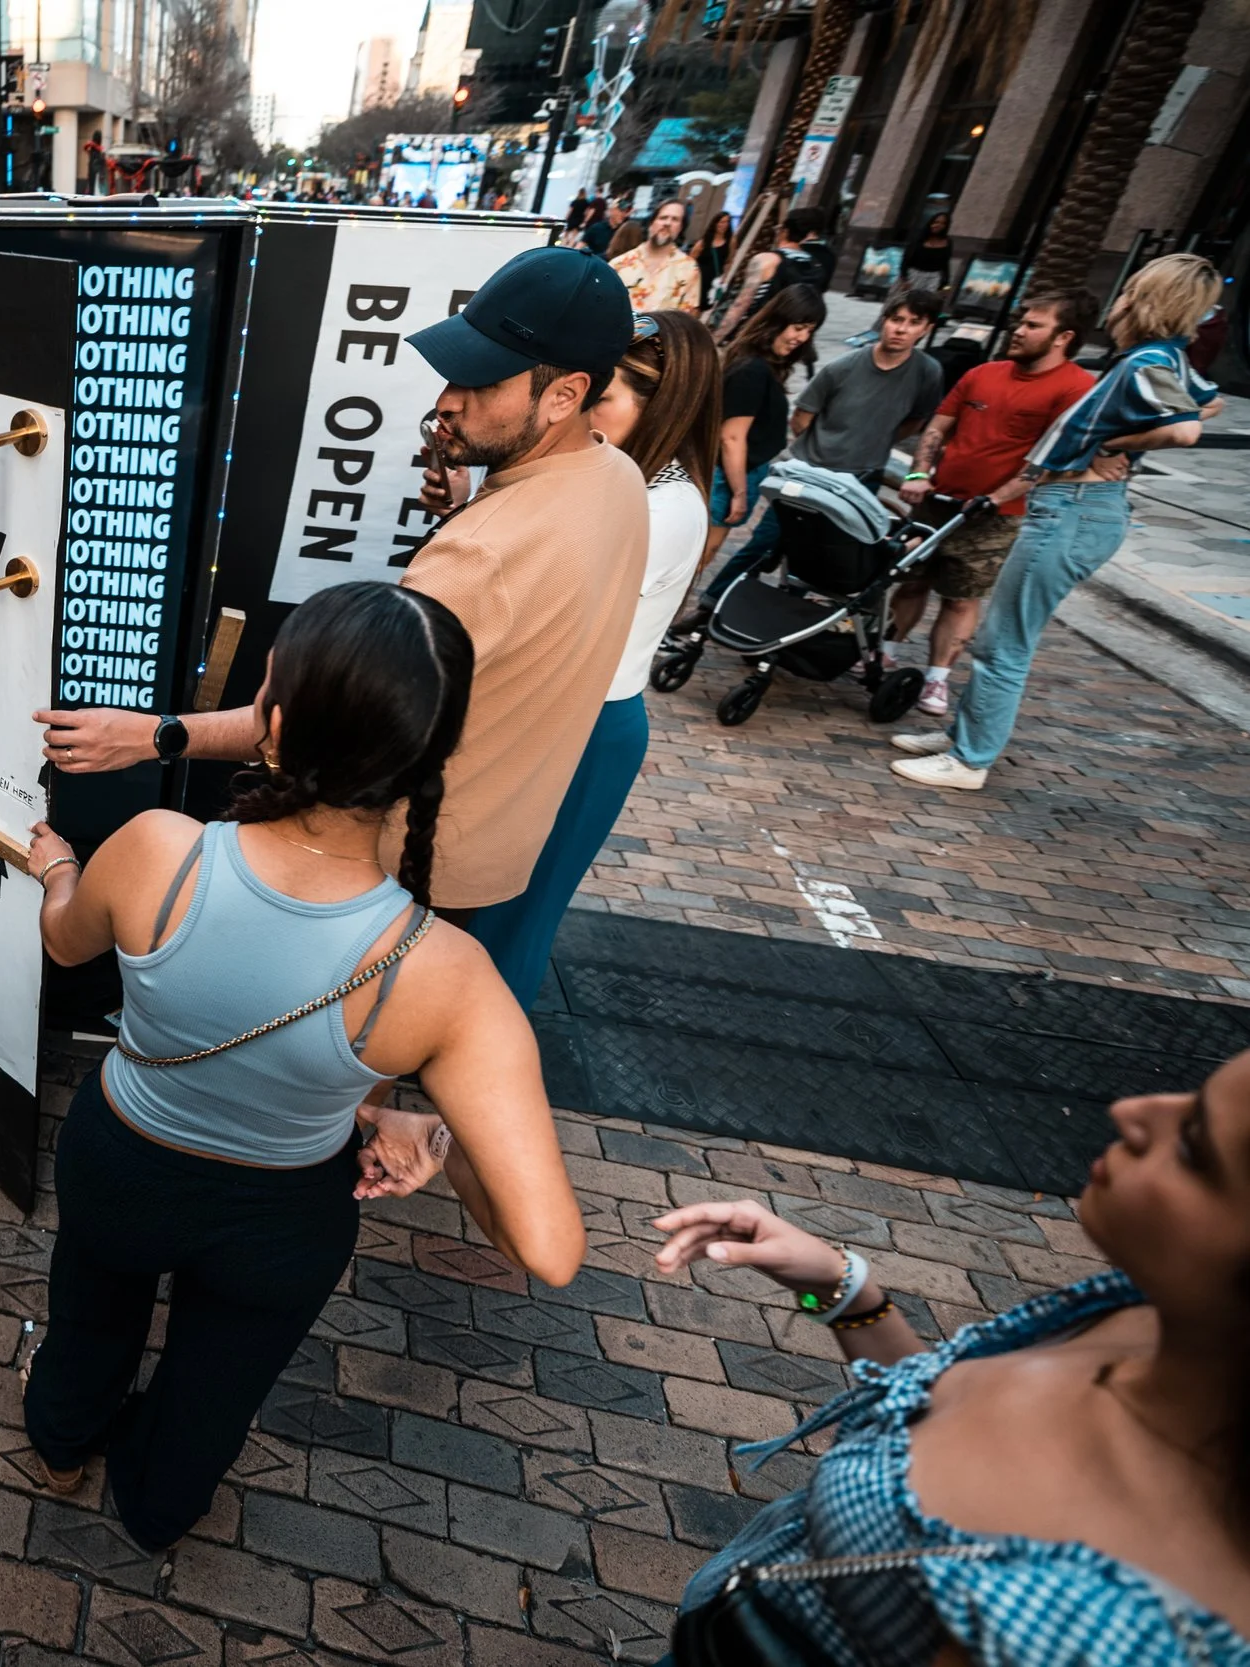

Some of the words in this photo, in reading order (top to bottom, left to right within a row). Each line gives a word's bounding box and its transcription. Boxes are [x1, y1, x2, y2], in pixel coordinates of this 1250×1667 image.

[78, 265, 195, 299] OTHING
[76, 303, 191, 337] OTHING
[335, 283, 411, 367] BE
[74, 340, 187, 373] OTHING
[73, 376, 184, 409] OTHING
[72, 411, 180, 443] OTHING
[70, 444, 177, 476] OTHING
[69, 477, 174, 508] OTHING
[298, 396, 384, 562] OPEN
[67, 508, 171, 539] OTHING
[65, 538, 168, 569] OTHING
[64, 568, 165, 599] OTHING
[62, 597, 162, 627] OTHING
[61, 624, 159, 655] OTHING
[60, 652, 156, 682] OTHING
[59, 678, 154, 708] OTHING
[12, 786, 34, 806] HERE
